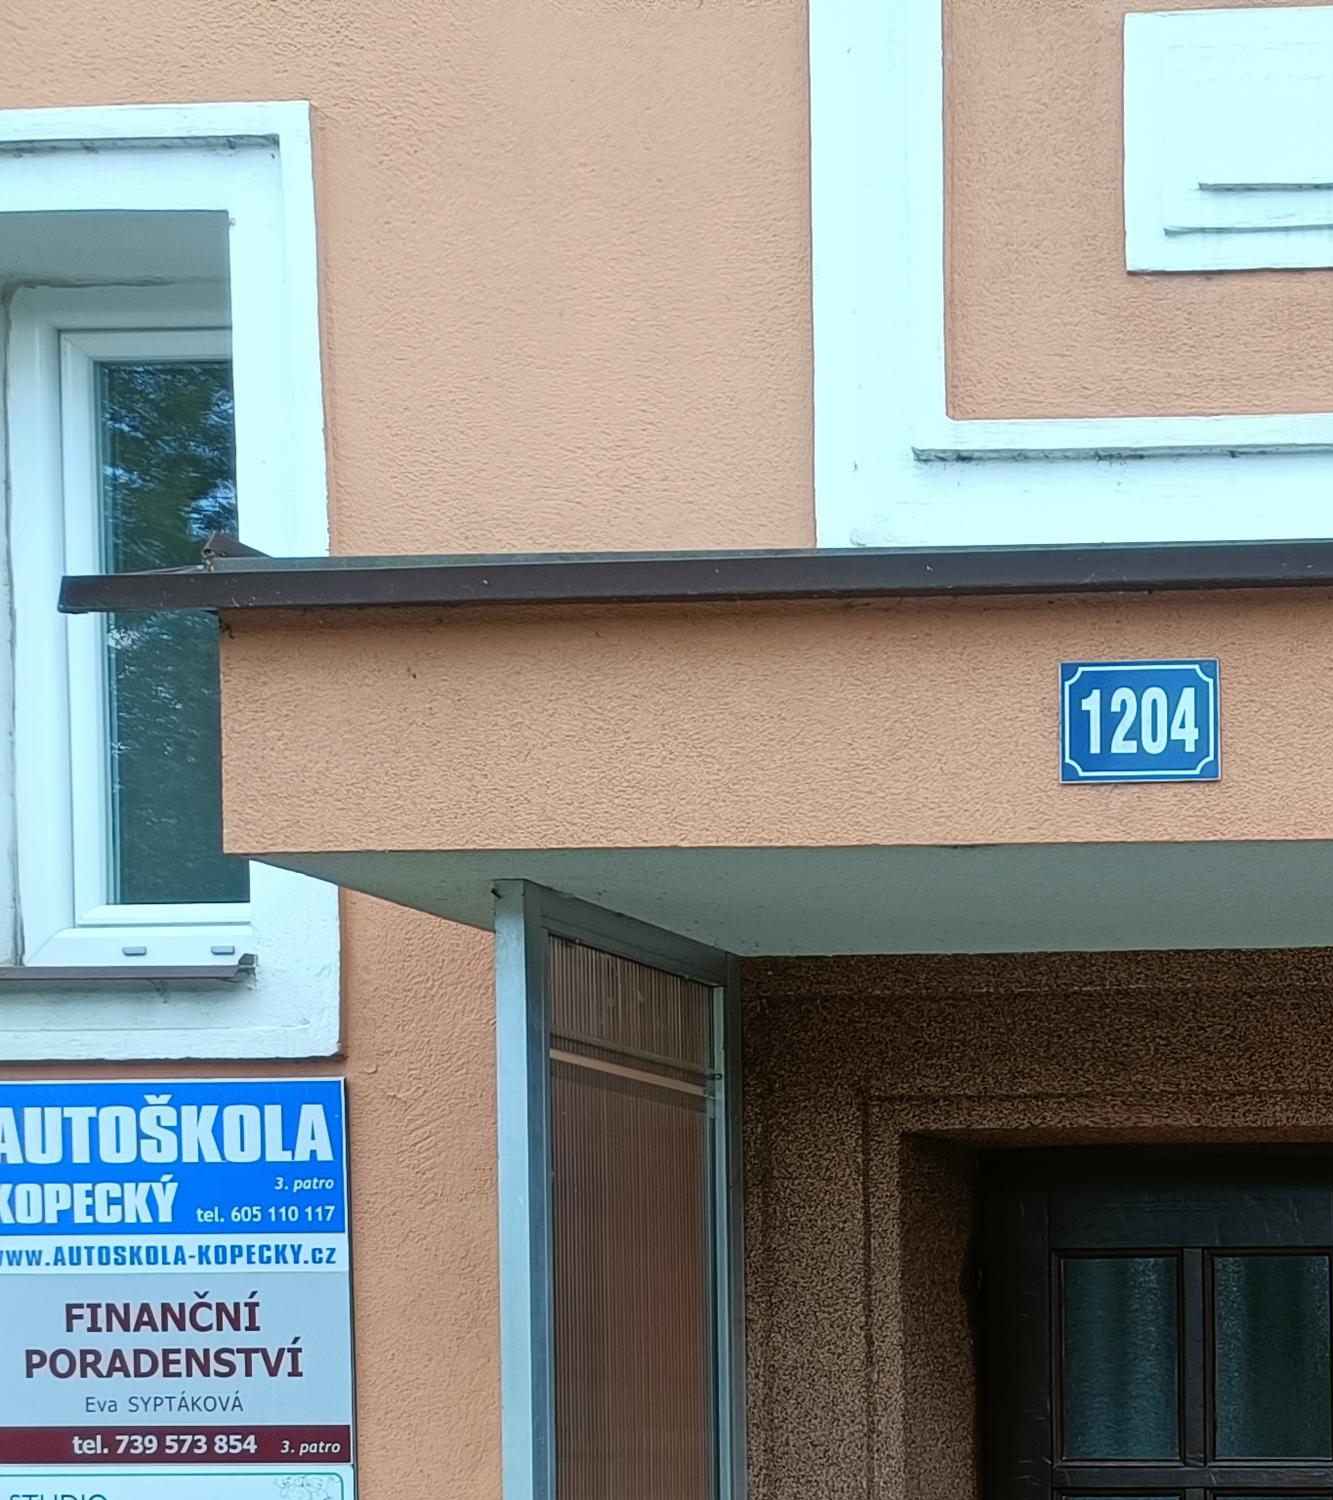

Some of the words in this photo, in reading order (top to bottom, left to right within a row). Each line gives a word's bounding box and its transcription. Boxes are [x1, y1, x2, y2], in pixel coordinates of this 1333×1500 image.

[1081, 687, 1199, 754] 1204
[0, 1094, 334, 1164] AUTOŠKOLA
[274, 1178, 289, 1190] 3.
[293, 1178, 334, 1193] patro
[197, 1207, 224, 1223] tel.
[231, 1206, 262, 1223] 605
[268, 1206, 299, 1222] 110
[306, 1206, 336, 1222] 117
[65, 1291, 261, 1332] FINANČNÍ
[25, 1337, 303, 1379] PORADENSTVÍ
[85, 1397, 118, 1413] Eva
[128, 1391, 244, 1413] SYPTÁKOVÁ
[72, 1435, 108, 1455] tel.
[115, 1435, 157, 1454] 739
[164, 1435, 207, 1454] 573
[214, 1434, 257, 1453] 854
[281, 1440, 294, 1453] 3.
[299, 1441, 340, 1456] patro
